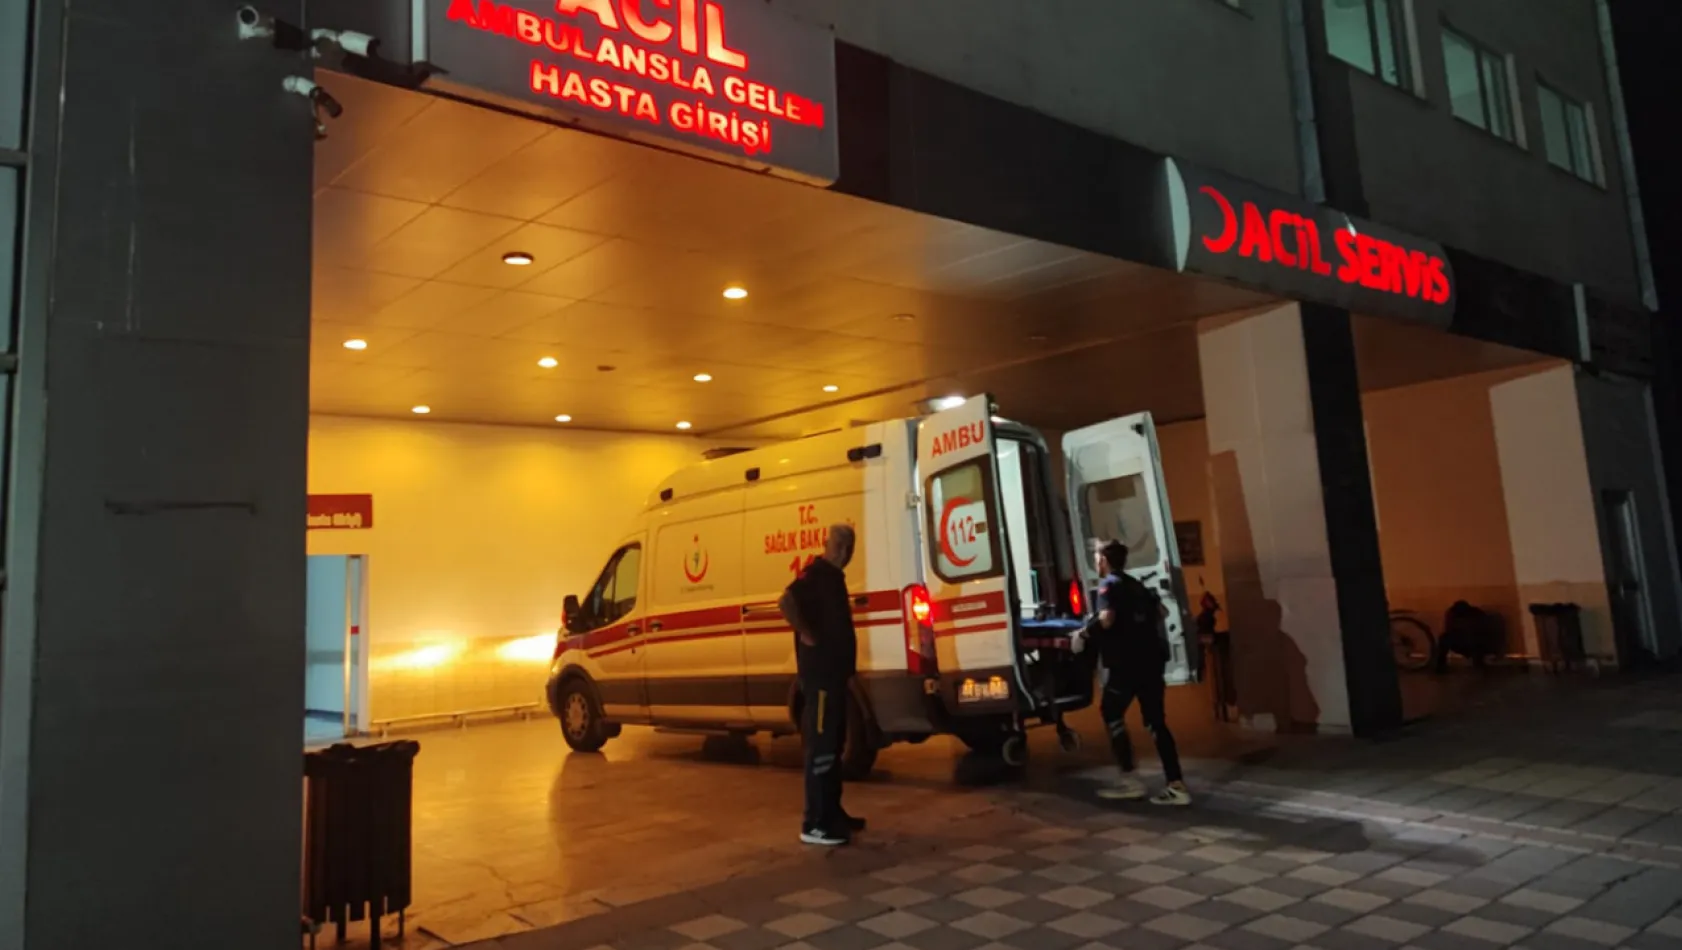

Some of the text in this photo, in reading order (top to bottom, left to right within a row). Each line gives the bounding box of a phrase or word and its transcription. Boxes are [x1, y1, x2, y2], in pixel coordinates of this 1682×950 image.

[447, 0, 824, 128] AMBULANSLA GELEN
[531, 62, 660, 123] HASTA
[1239, 201, 1450, 304] ACİL SERVİS
[931, 420, 985, 457] AMBU
[764, 528, 798, 554] SAĞLIK
[951, 516, 976, 546] 112
